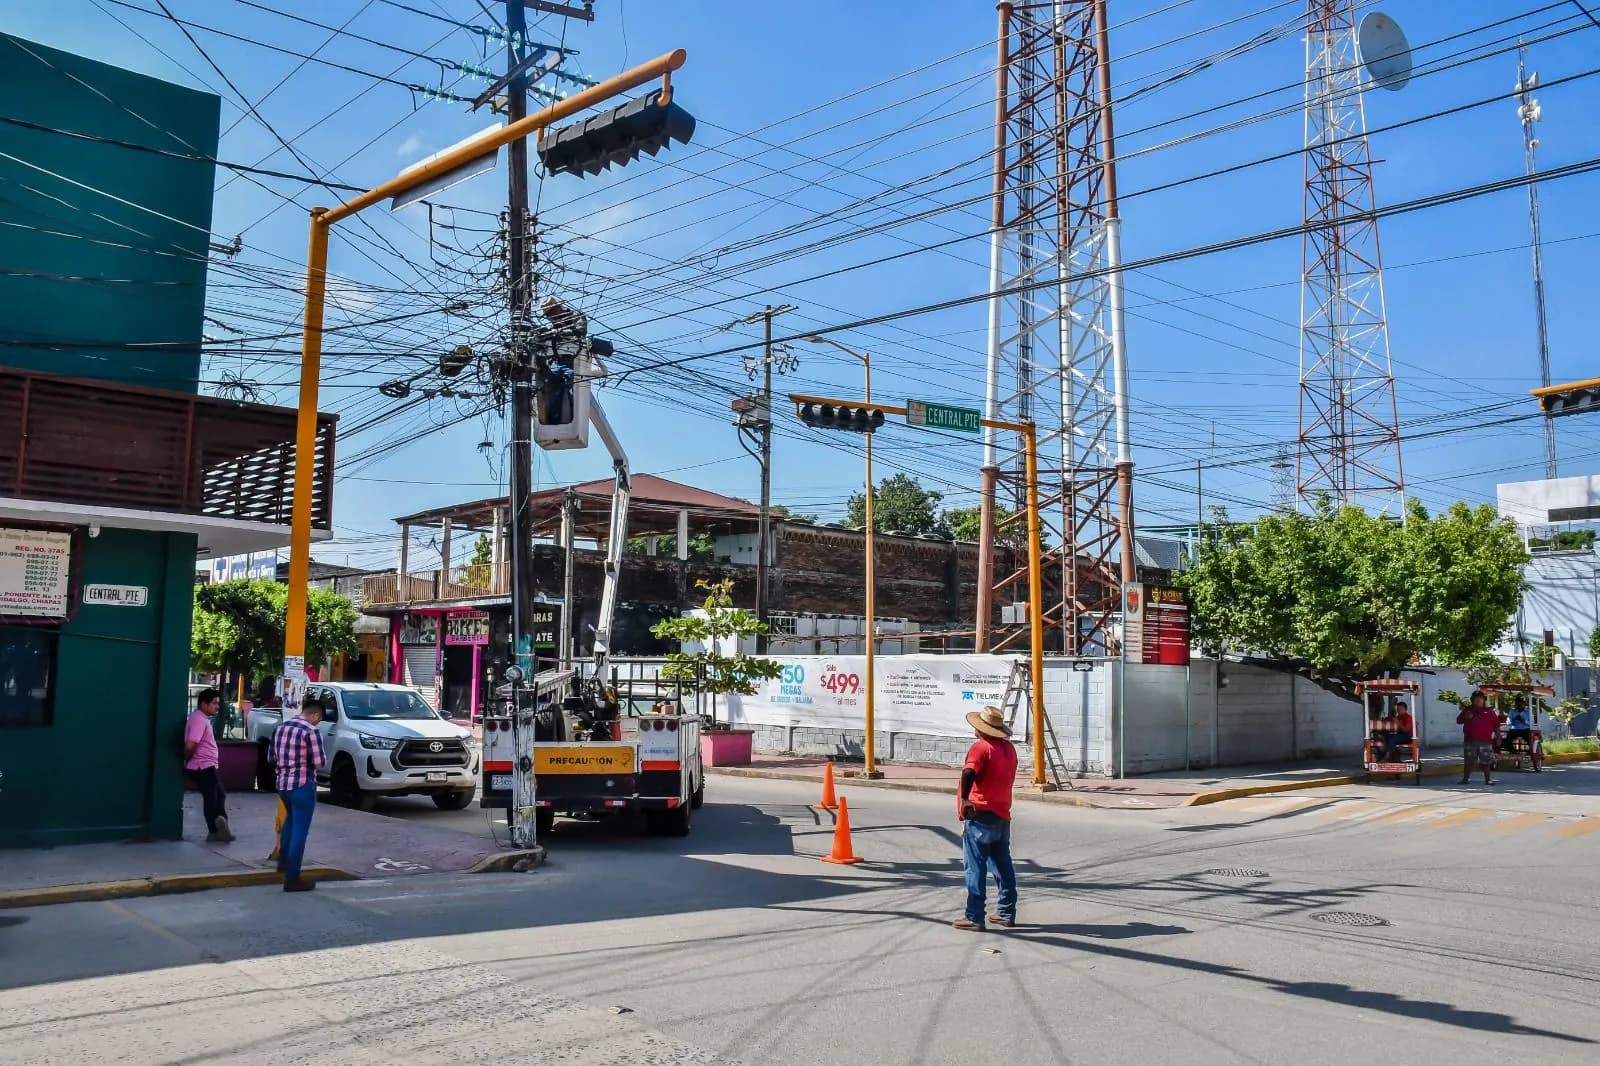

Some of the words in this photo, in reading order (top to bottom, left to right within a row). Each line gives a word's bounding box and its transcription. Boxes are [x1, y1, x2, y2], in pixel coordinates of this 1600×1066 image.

[928, 408, 963, 426] CENTRAL
[965, 414, 979, 428] PTE
[90, 588, 121, 600] CENTRAL
[125, 590, 140, 601] PTE
[820, 673, 860, 694] $499
[780, 685, 802, 696] MEGAS
[976, 692, 1004, 700] TELMEX
